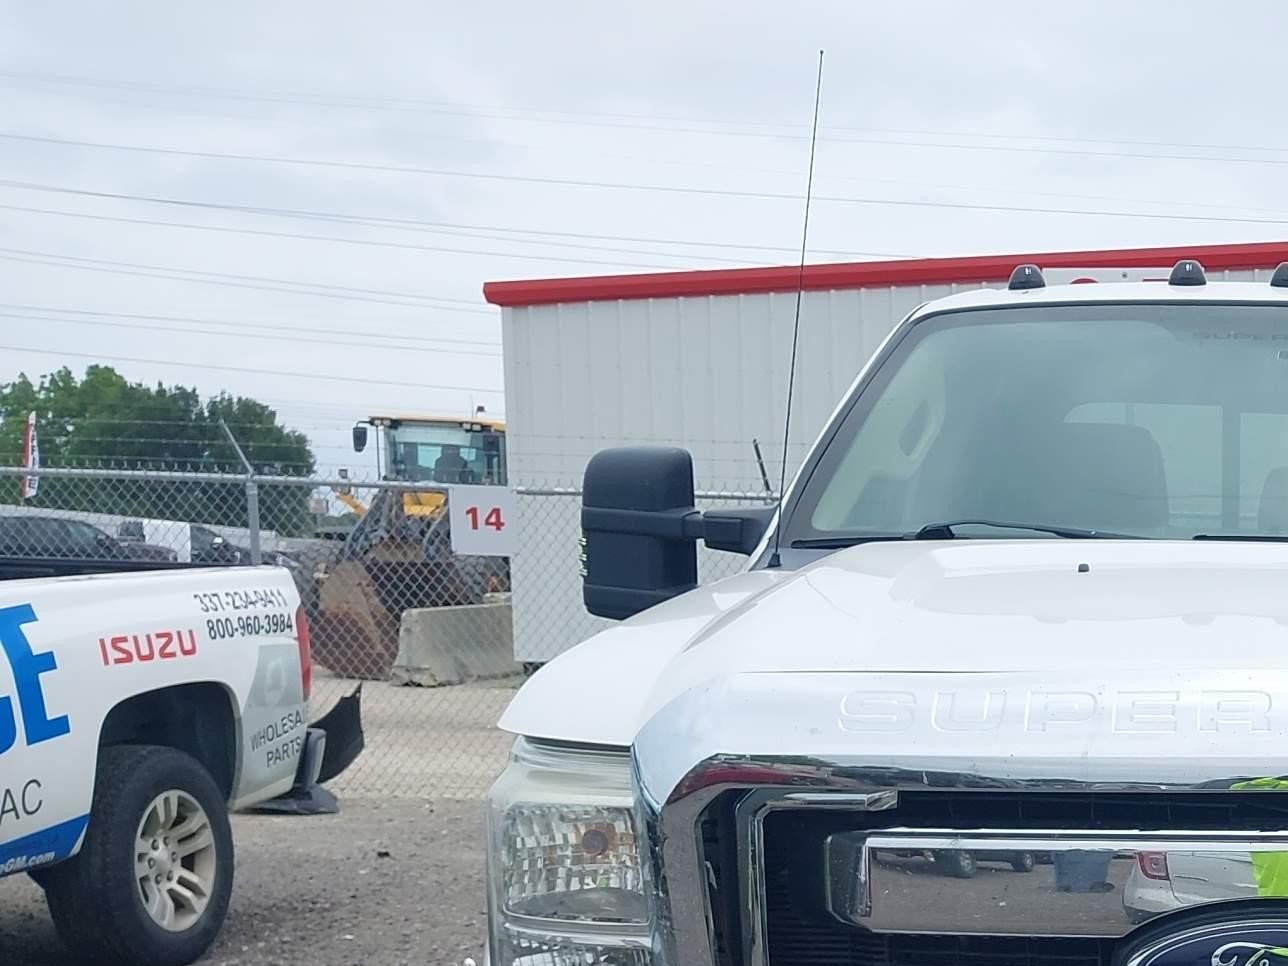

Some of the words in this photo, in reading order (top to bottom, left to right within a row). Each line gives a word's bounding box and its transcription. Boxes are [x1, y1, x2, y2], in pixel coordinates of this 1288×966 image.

[465, 506, 505, 531] 14
[193, 589, 287, 613] 337-234-9411
[206, 612, 293, 640] 800-960-3984
[98, 629, 197, 666] ISUZU
[0, 603, 70, 755] E
[838, 690, 1273, 733] SUPER
[266, 736, 301, 768] PARTS
